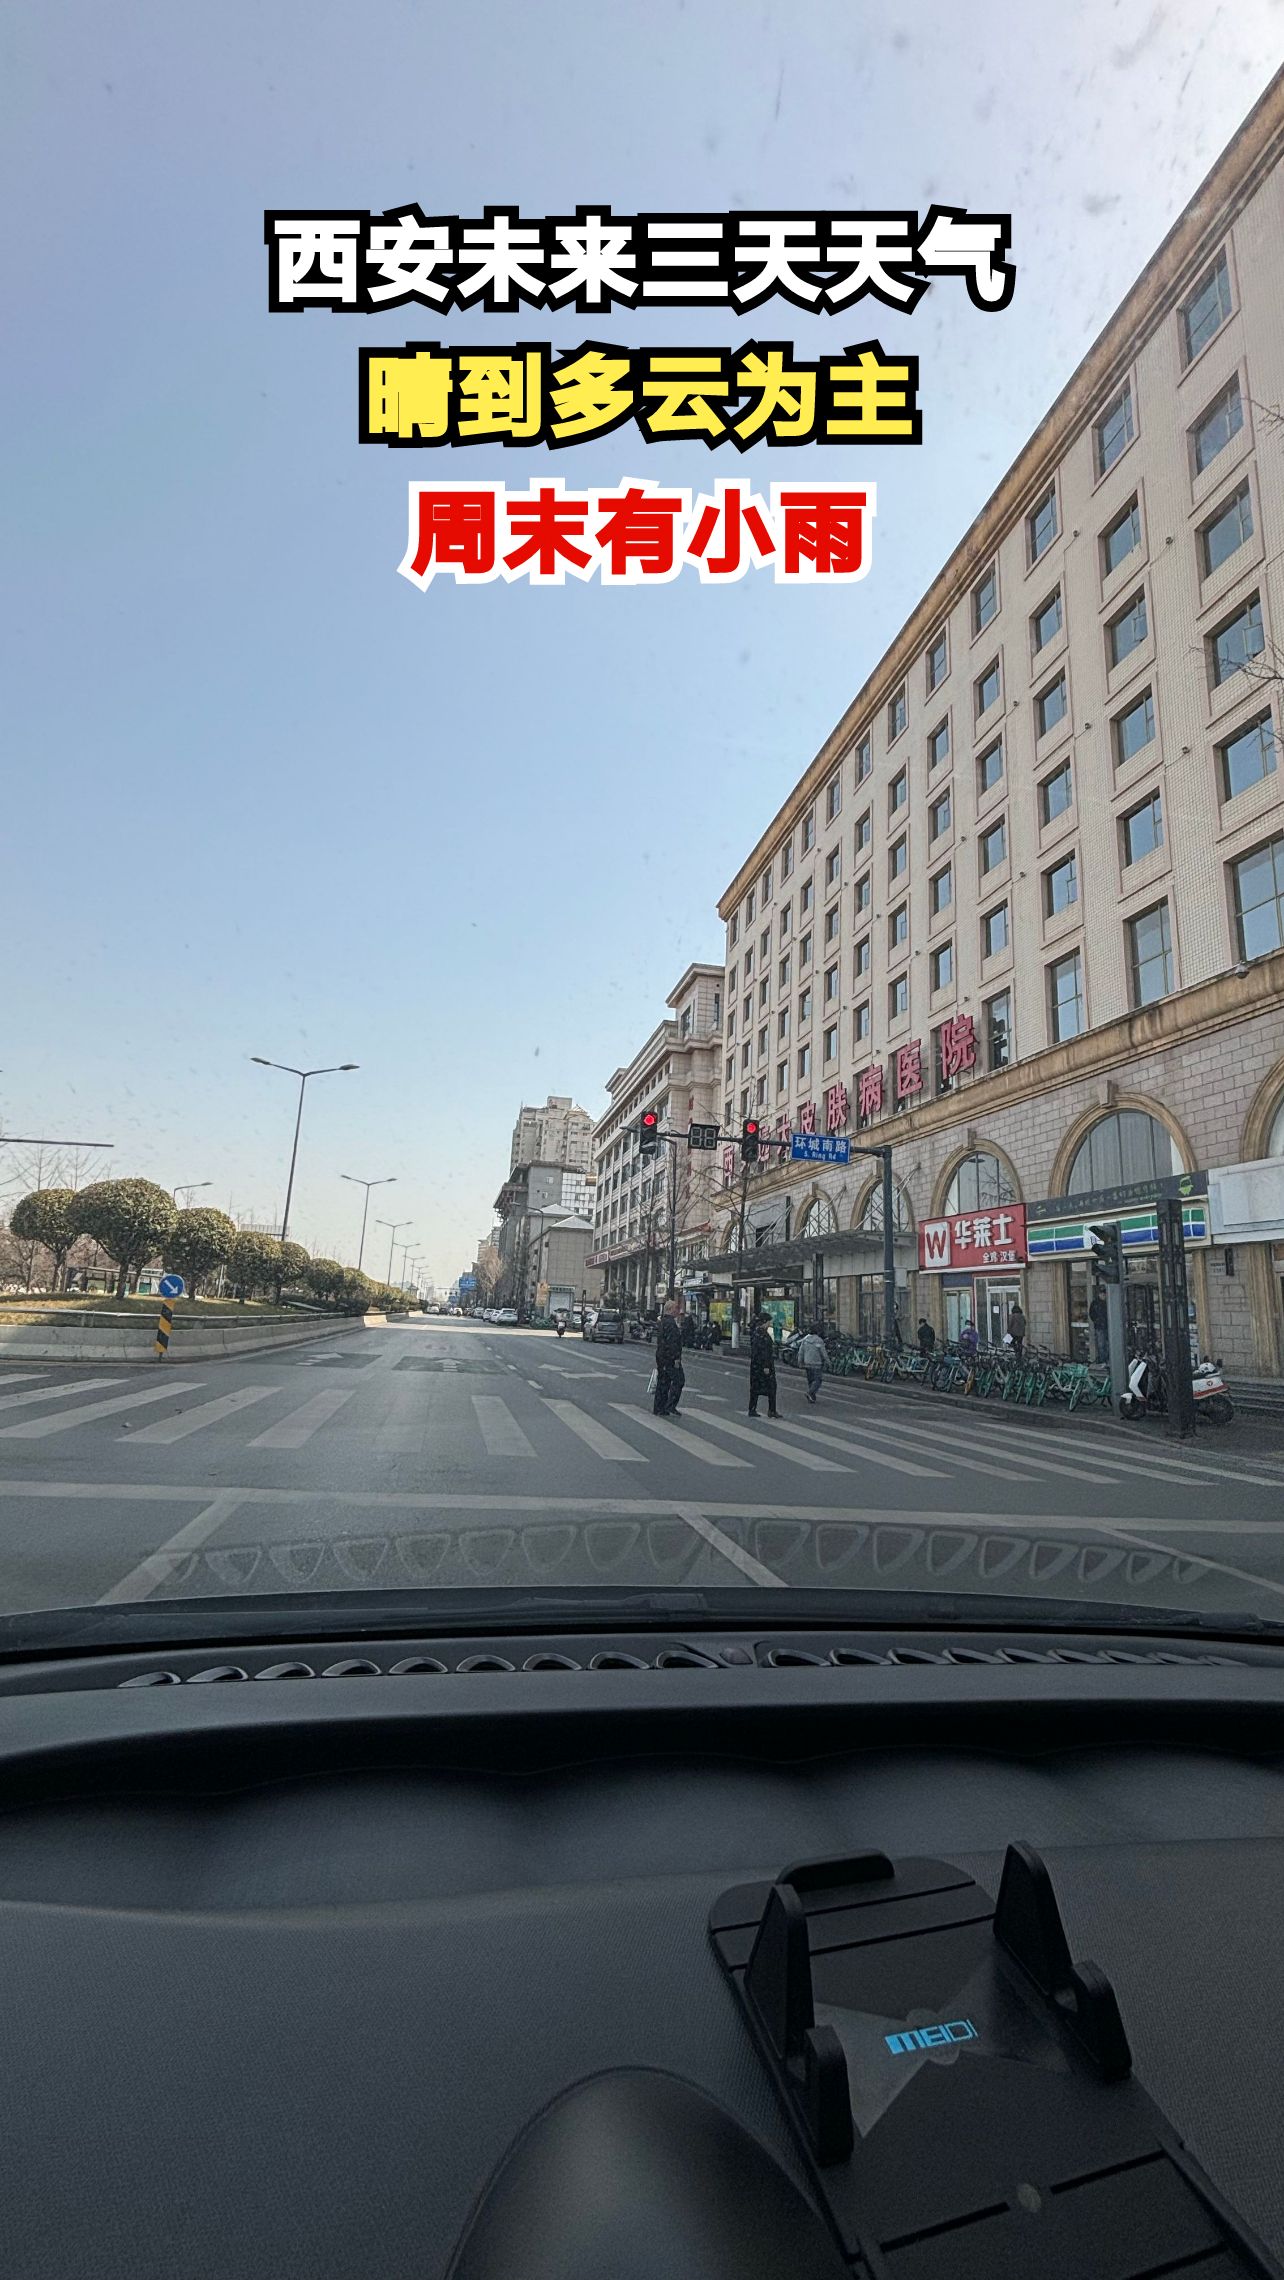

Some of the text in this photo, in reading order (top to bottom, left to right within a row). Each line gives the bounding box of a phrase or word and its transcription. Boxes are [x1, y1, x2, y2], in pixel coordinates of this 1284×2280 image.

[794, 1136, 847, 1153] 环城南路
[811, 1151, 826, 1160] Ring
[828, 1152, 837, 1161] Rd
[954, 1213, 1014, 1250] 华莱士
[926, 1230, 947, 1260] W
